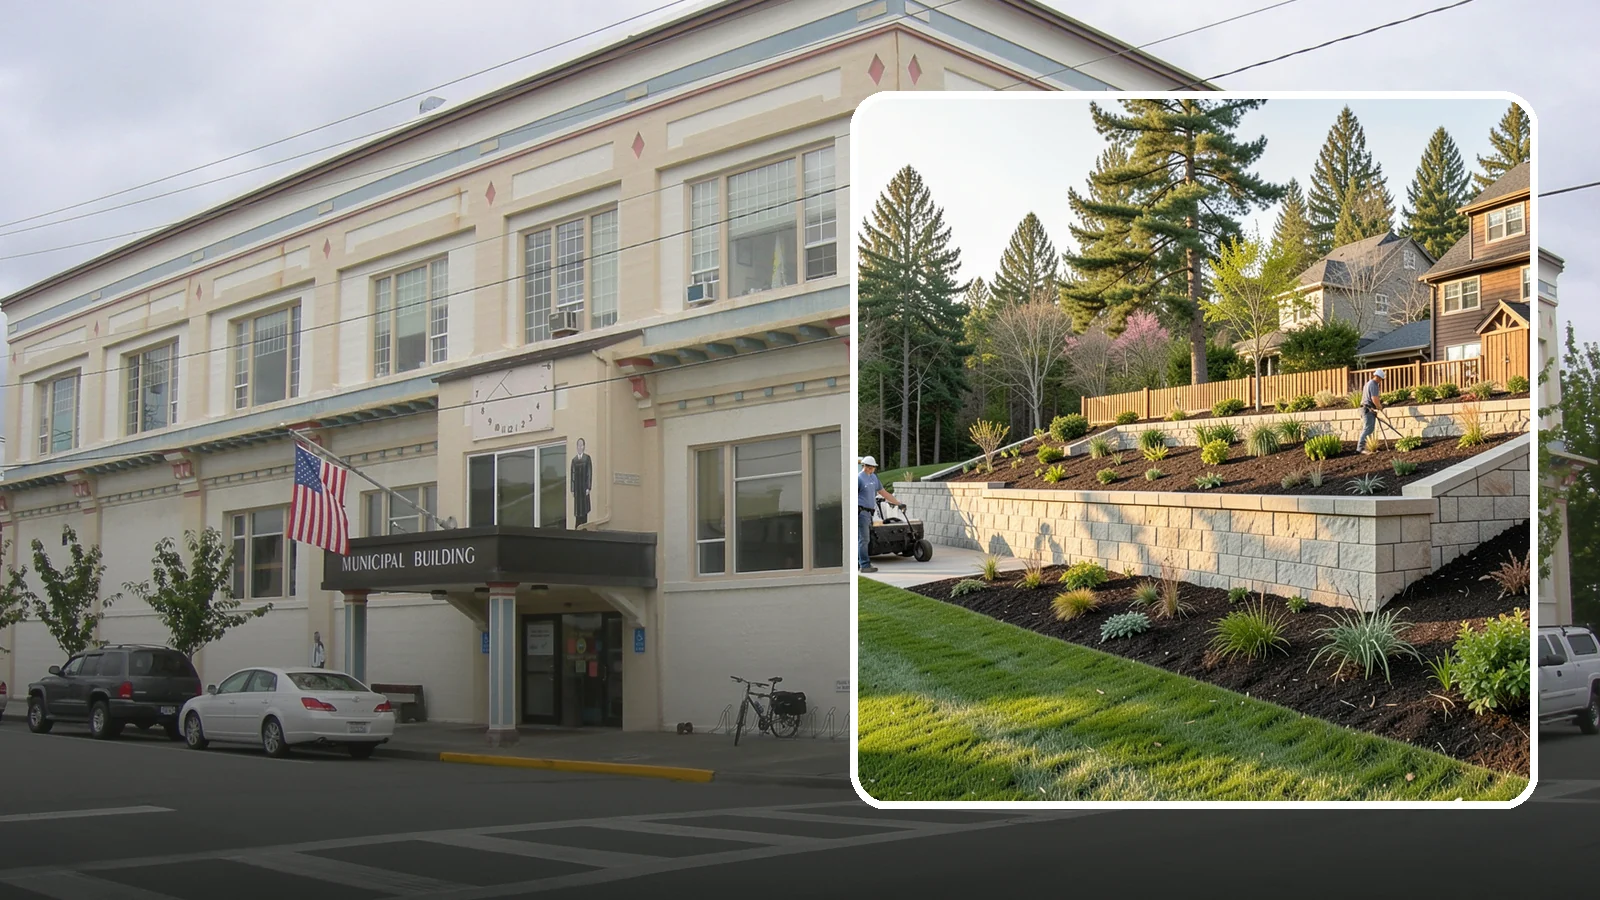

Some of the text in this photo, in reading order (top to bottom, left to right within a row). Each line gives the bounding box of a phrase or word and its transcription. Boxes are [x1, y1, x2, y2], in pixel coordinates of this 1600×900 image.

[480, 407, 485, 415] 8
[487, 417, 492, 426] 9
[494, 424, 500, 432] 10
[507, 426, 514, 434] 12
[521, 420, 526, 428] 2
[529, 414, 533, 422] 3
[536, 402, 540, 410] 4
[341, 546, 476, 572] MUNICIPAL BUILDING
